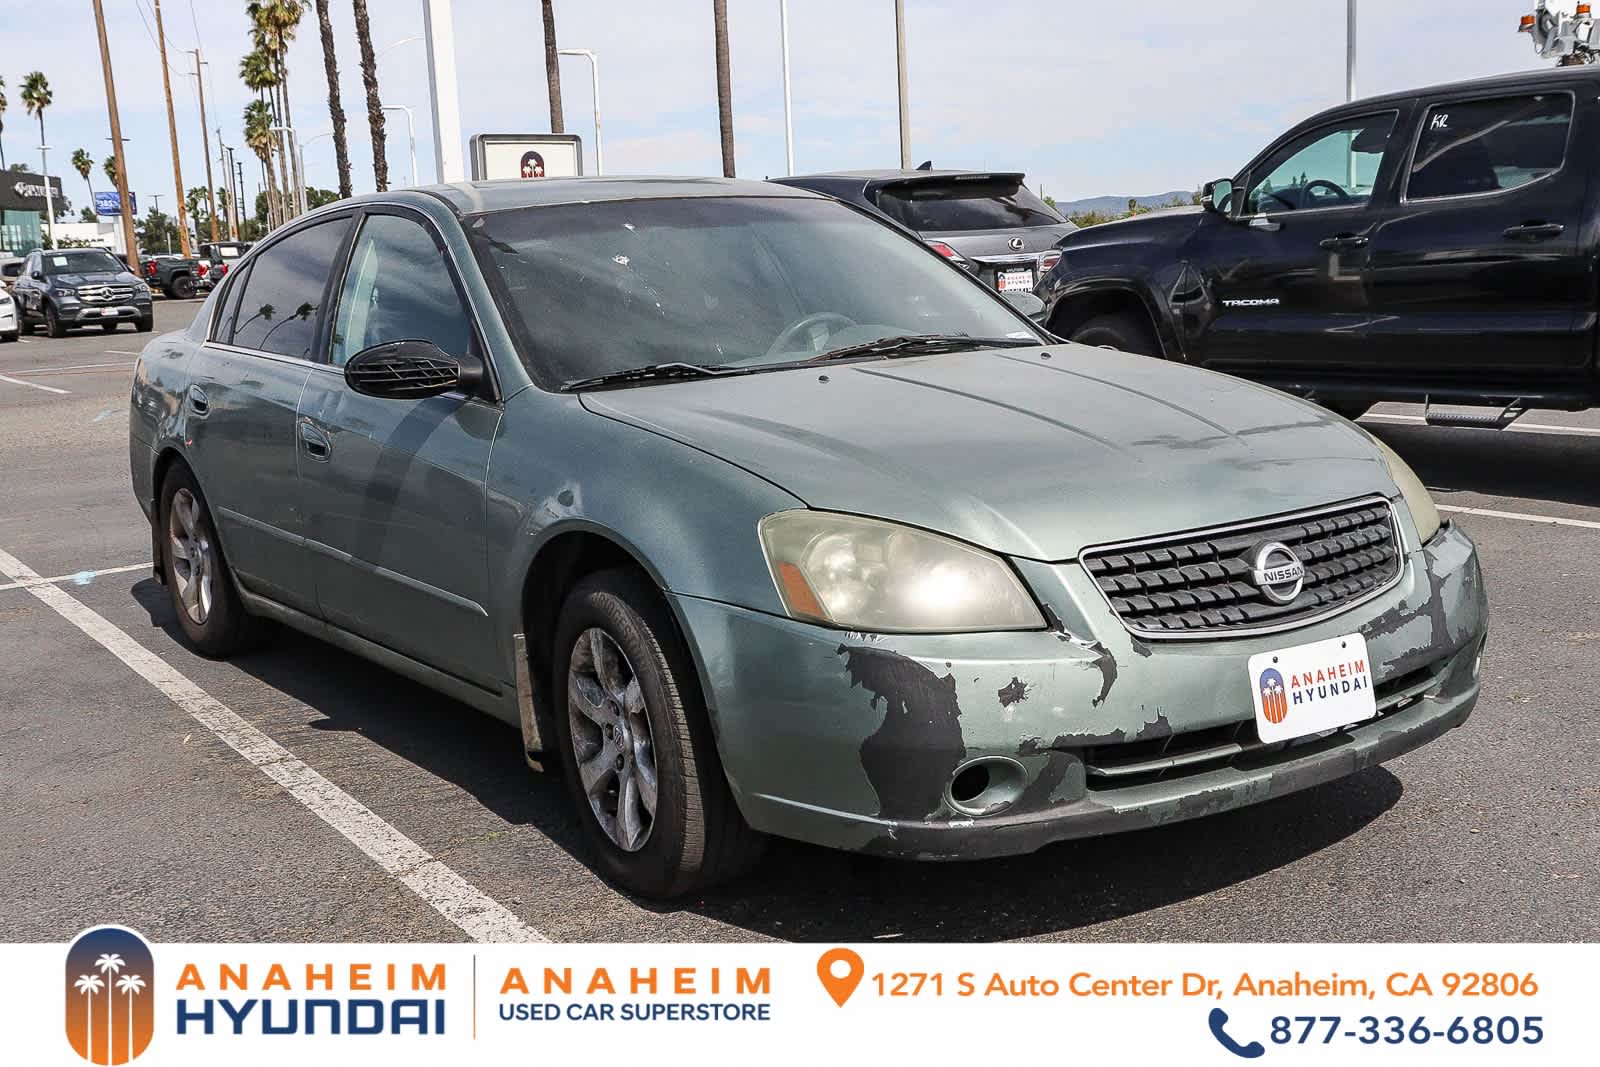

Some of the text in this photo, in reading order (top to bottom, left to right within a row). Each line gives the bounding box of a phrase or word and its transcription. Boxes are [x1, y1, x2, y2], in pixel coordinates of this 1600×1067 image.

[1222, 298, 1280, 306] TACOMA
[1264, 565, 1303, 582] NISSAN
[1291, 659, 1365, 688] ANAHEIM
[1292, 675, 1368, 705] HYUNDAI
